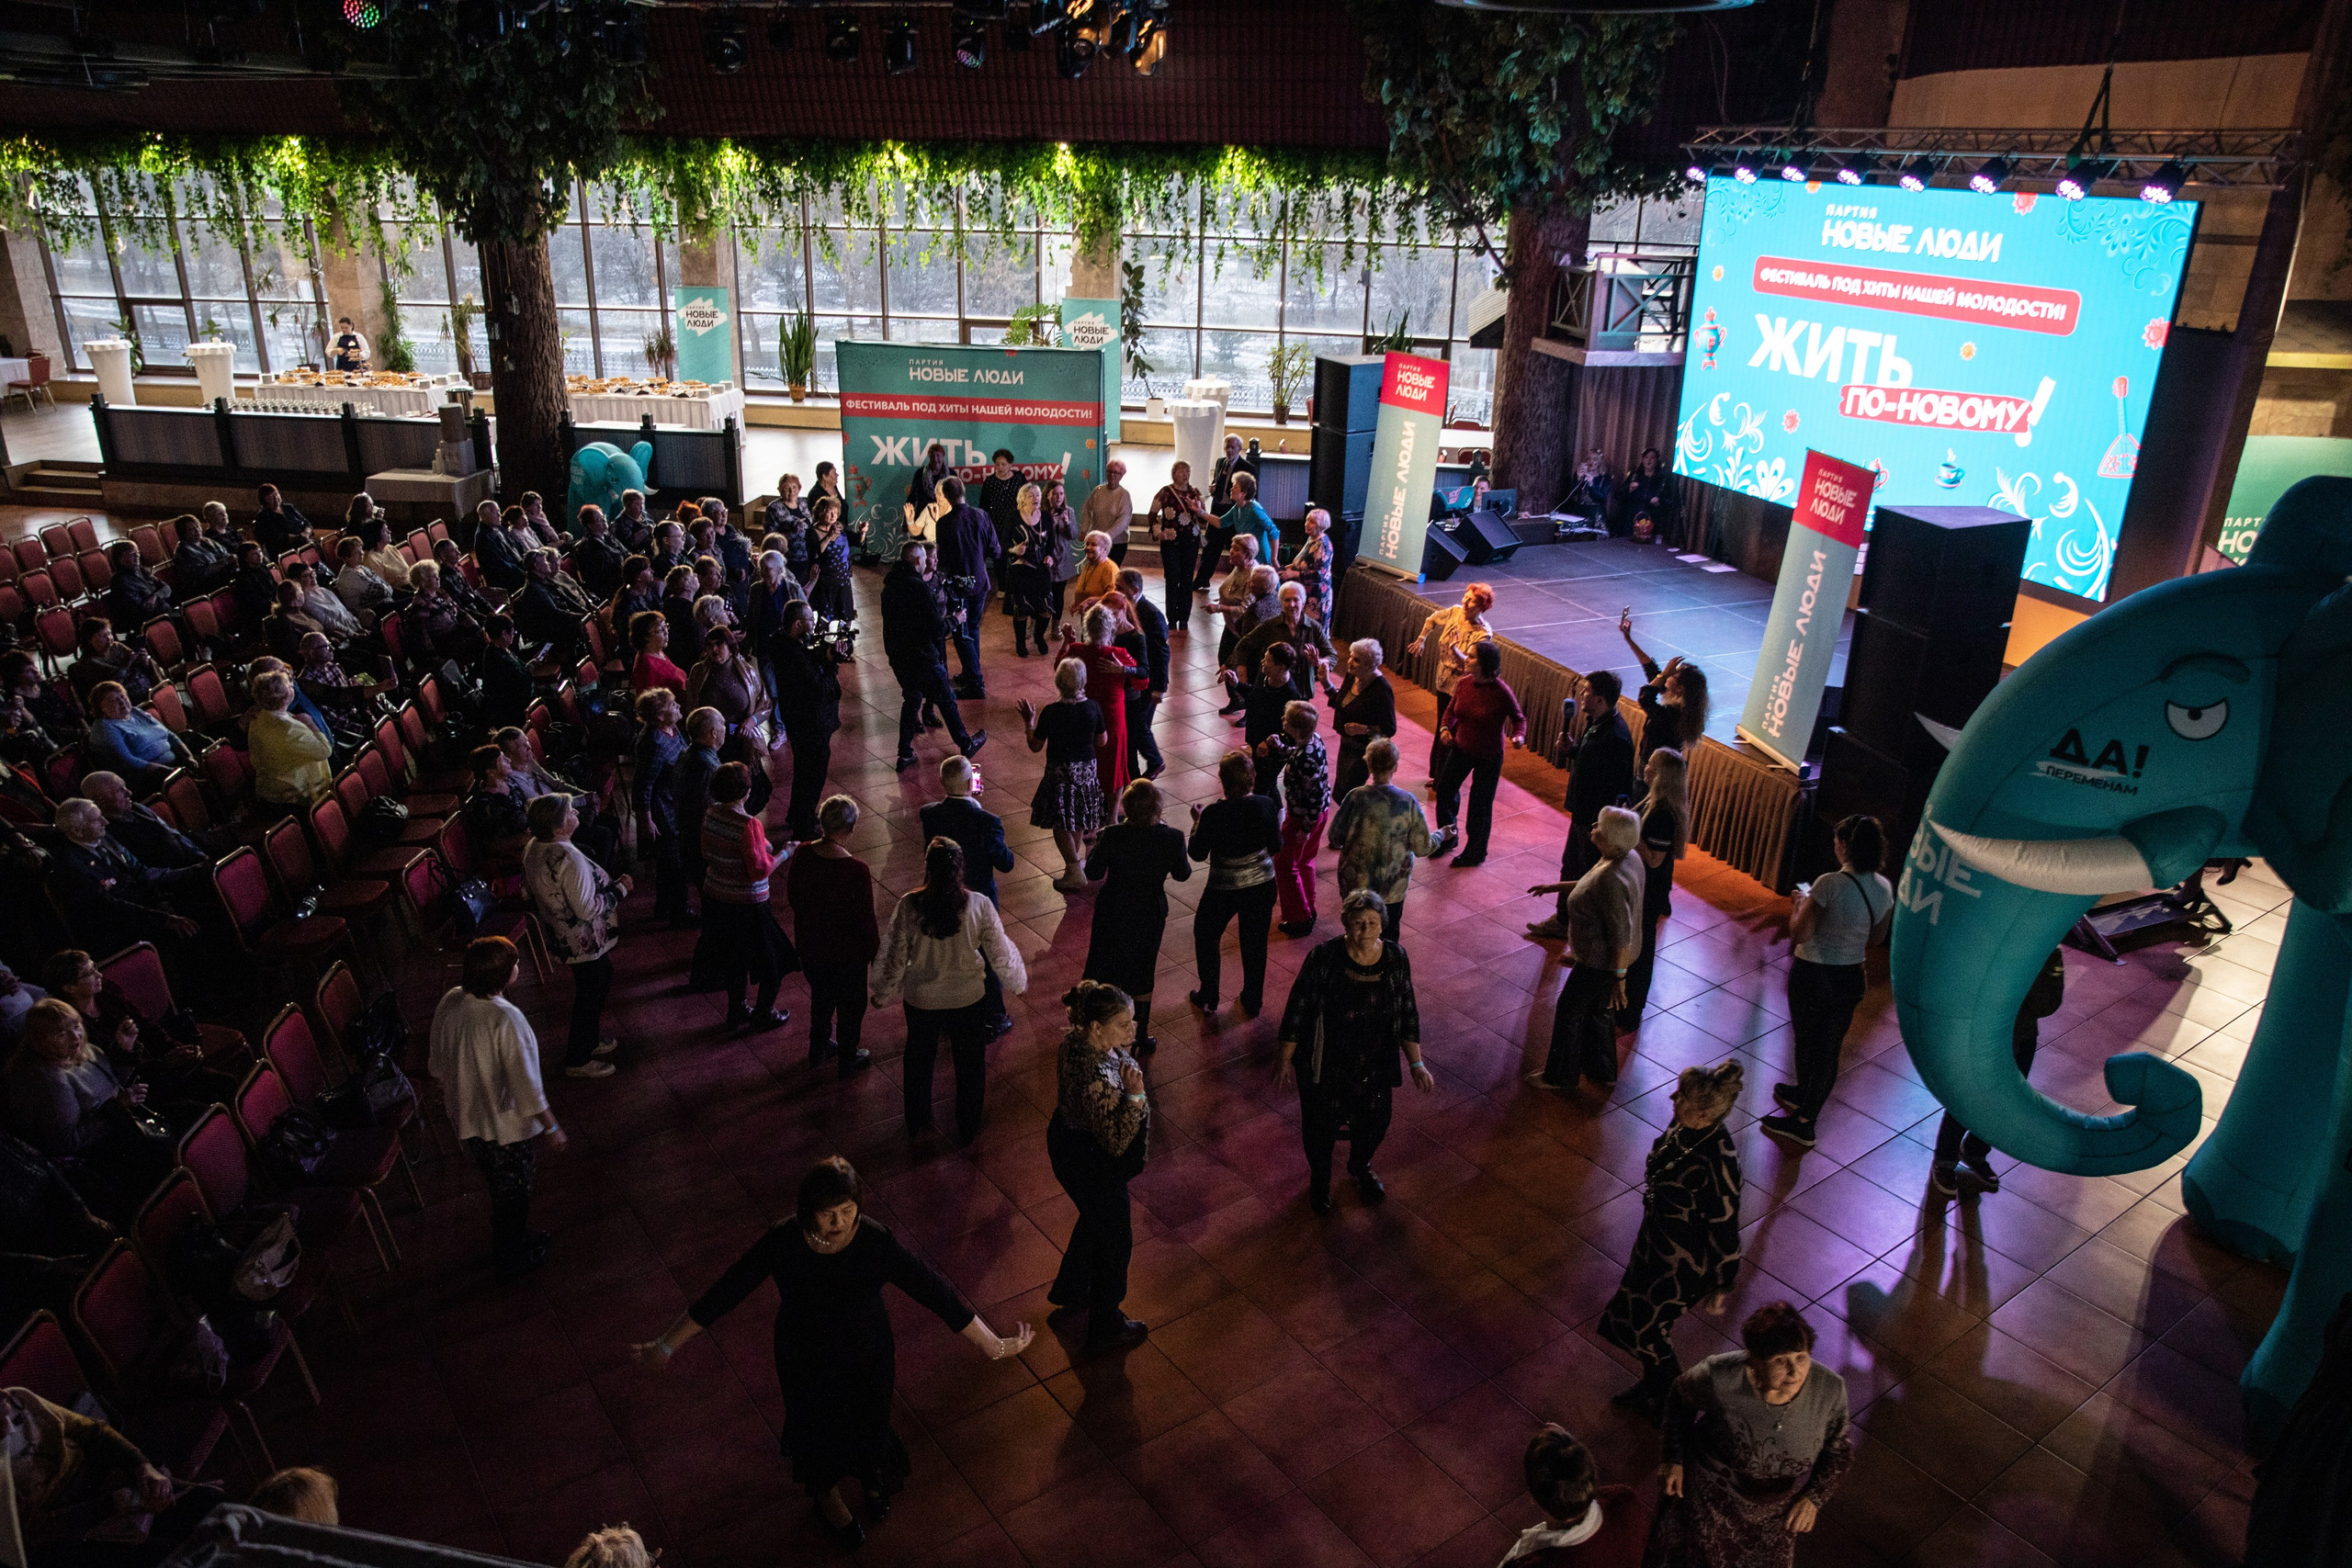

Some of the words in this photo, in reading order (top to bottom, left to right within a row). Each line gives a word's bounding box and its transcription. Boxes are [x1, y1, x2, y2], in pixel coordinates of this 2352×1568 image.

[1826, 203, 1878, 220] ПАРТИЯ
[1822, 219, 1913, 254] НОВЫЕ
[1915, 227, 2004, 264] ЛЮДИ
[1760, 267, 1831, 290] ФЕСТИВАЛЬ
[1832, 276, 1861, 296] ПОД
[1861, 279, 1902, 299] ХИТЫ
[1901, 285, 1956, 306] НАШЕЙ
[1956, 291, 2067, 321] МОЛОДОСТИ!
[685, 310, 718, 319] НОВЫЕ
[686, 320, 714, 328] ЛЮДИ
[1073, 326, 1109, 334] НОВЫЕ
[1073, 336, 1103, 344] ЛЮДИ
[1747, 313, 1914, 387] ЖИТЬ
[909, 367, 969, 382] НОВЫЕ
[974, 369, 1023, 385] ЛЮДИ
[1396, 369, 1435, 389] НОВЫЕ
[1395, 384, 1428, 402] ЛЮДИ
[846, 400, 910, 412] ФЕСТИВАЛЬ
[912, 402, 937, 413] ПОД
[938, 404, 969, 413] ХИТЫ
[971, 404, 1012, 415] НАШЕЙ
[1014, 406, 1092, 419] МОЛОДОСТИ!
[870, 434, 987, 467] ЖИТЬ
[1818, 468, 1843, 483] ПАРТИЯ
[1385, 486, 1407, 559] НОВЫЕ
[1397, 420, 1417, 484] ЛЮДИ
[1814, 478, 1858, 509] НОВЫЕ
[1809, 497, 1846, 525] ЛЮДИ
[2223, 517, 2264, 527] ПАРТ
[1768, 638, 1804, 739] НОВЫЕ
[1795, 549, 1826, 636] ЛЮДИ
[1761, 674, 1780, 730] ПАРТИЯ
[2049, 728, 2150, 778] ДА!
[2045, 765, 2140, 795] ПЕРЕМЕНАМ
